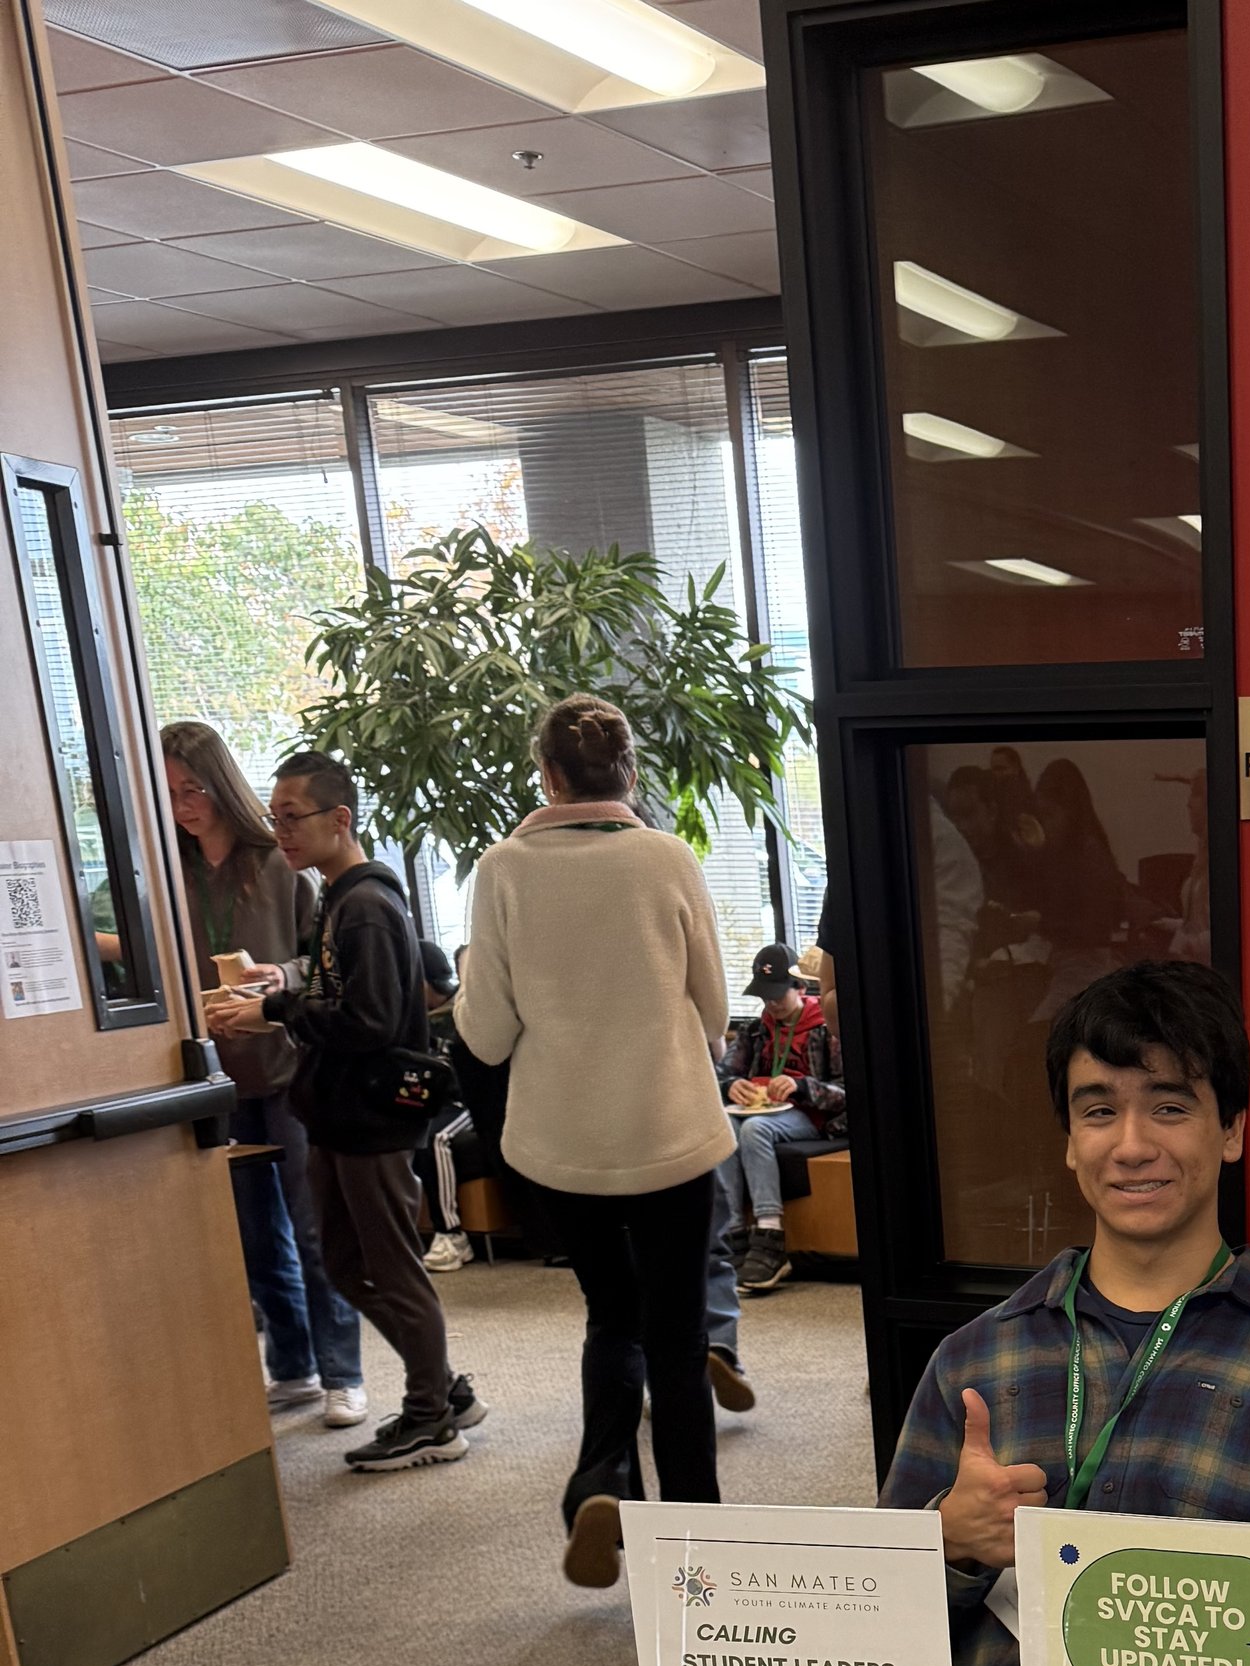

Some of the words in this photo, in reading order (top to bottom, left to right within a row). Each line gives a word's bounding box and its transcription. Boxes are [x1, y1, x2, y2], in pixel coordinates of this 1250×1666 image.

[730, 1572, 777, 1588] SAN
[791, 1574, 878, 1592] MATEO
[1111, 1573, 1230, 1603] FOLLOW
[734, 1599, 772, 1608] YOUTH
[779, 1601, 828, 1610] CLIMATE
[836, 1603, 879, 1612] ACTION
[1098, 1598, 1198, 1628] SVYCA
[1209, 1605, 1245, 1631] TO
[697, 1624, 796, 1644] CALLING
[1135, 1626, 1209, 1653] STAY
